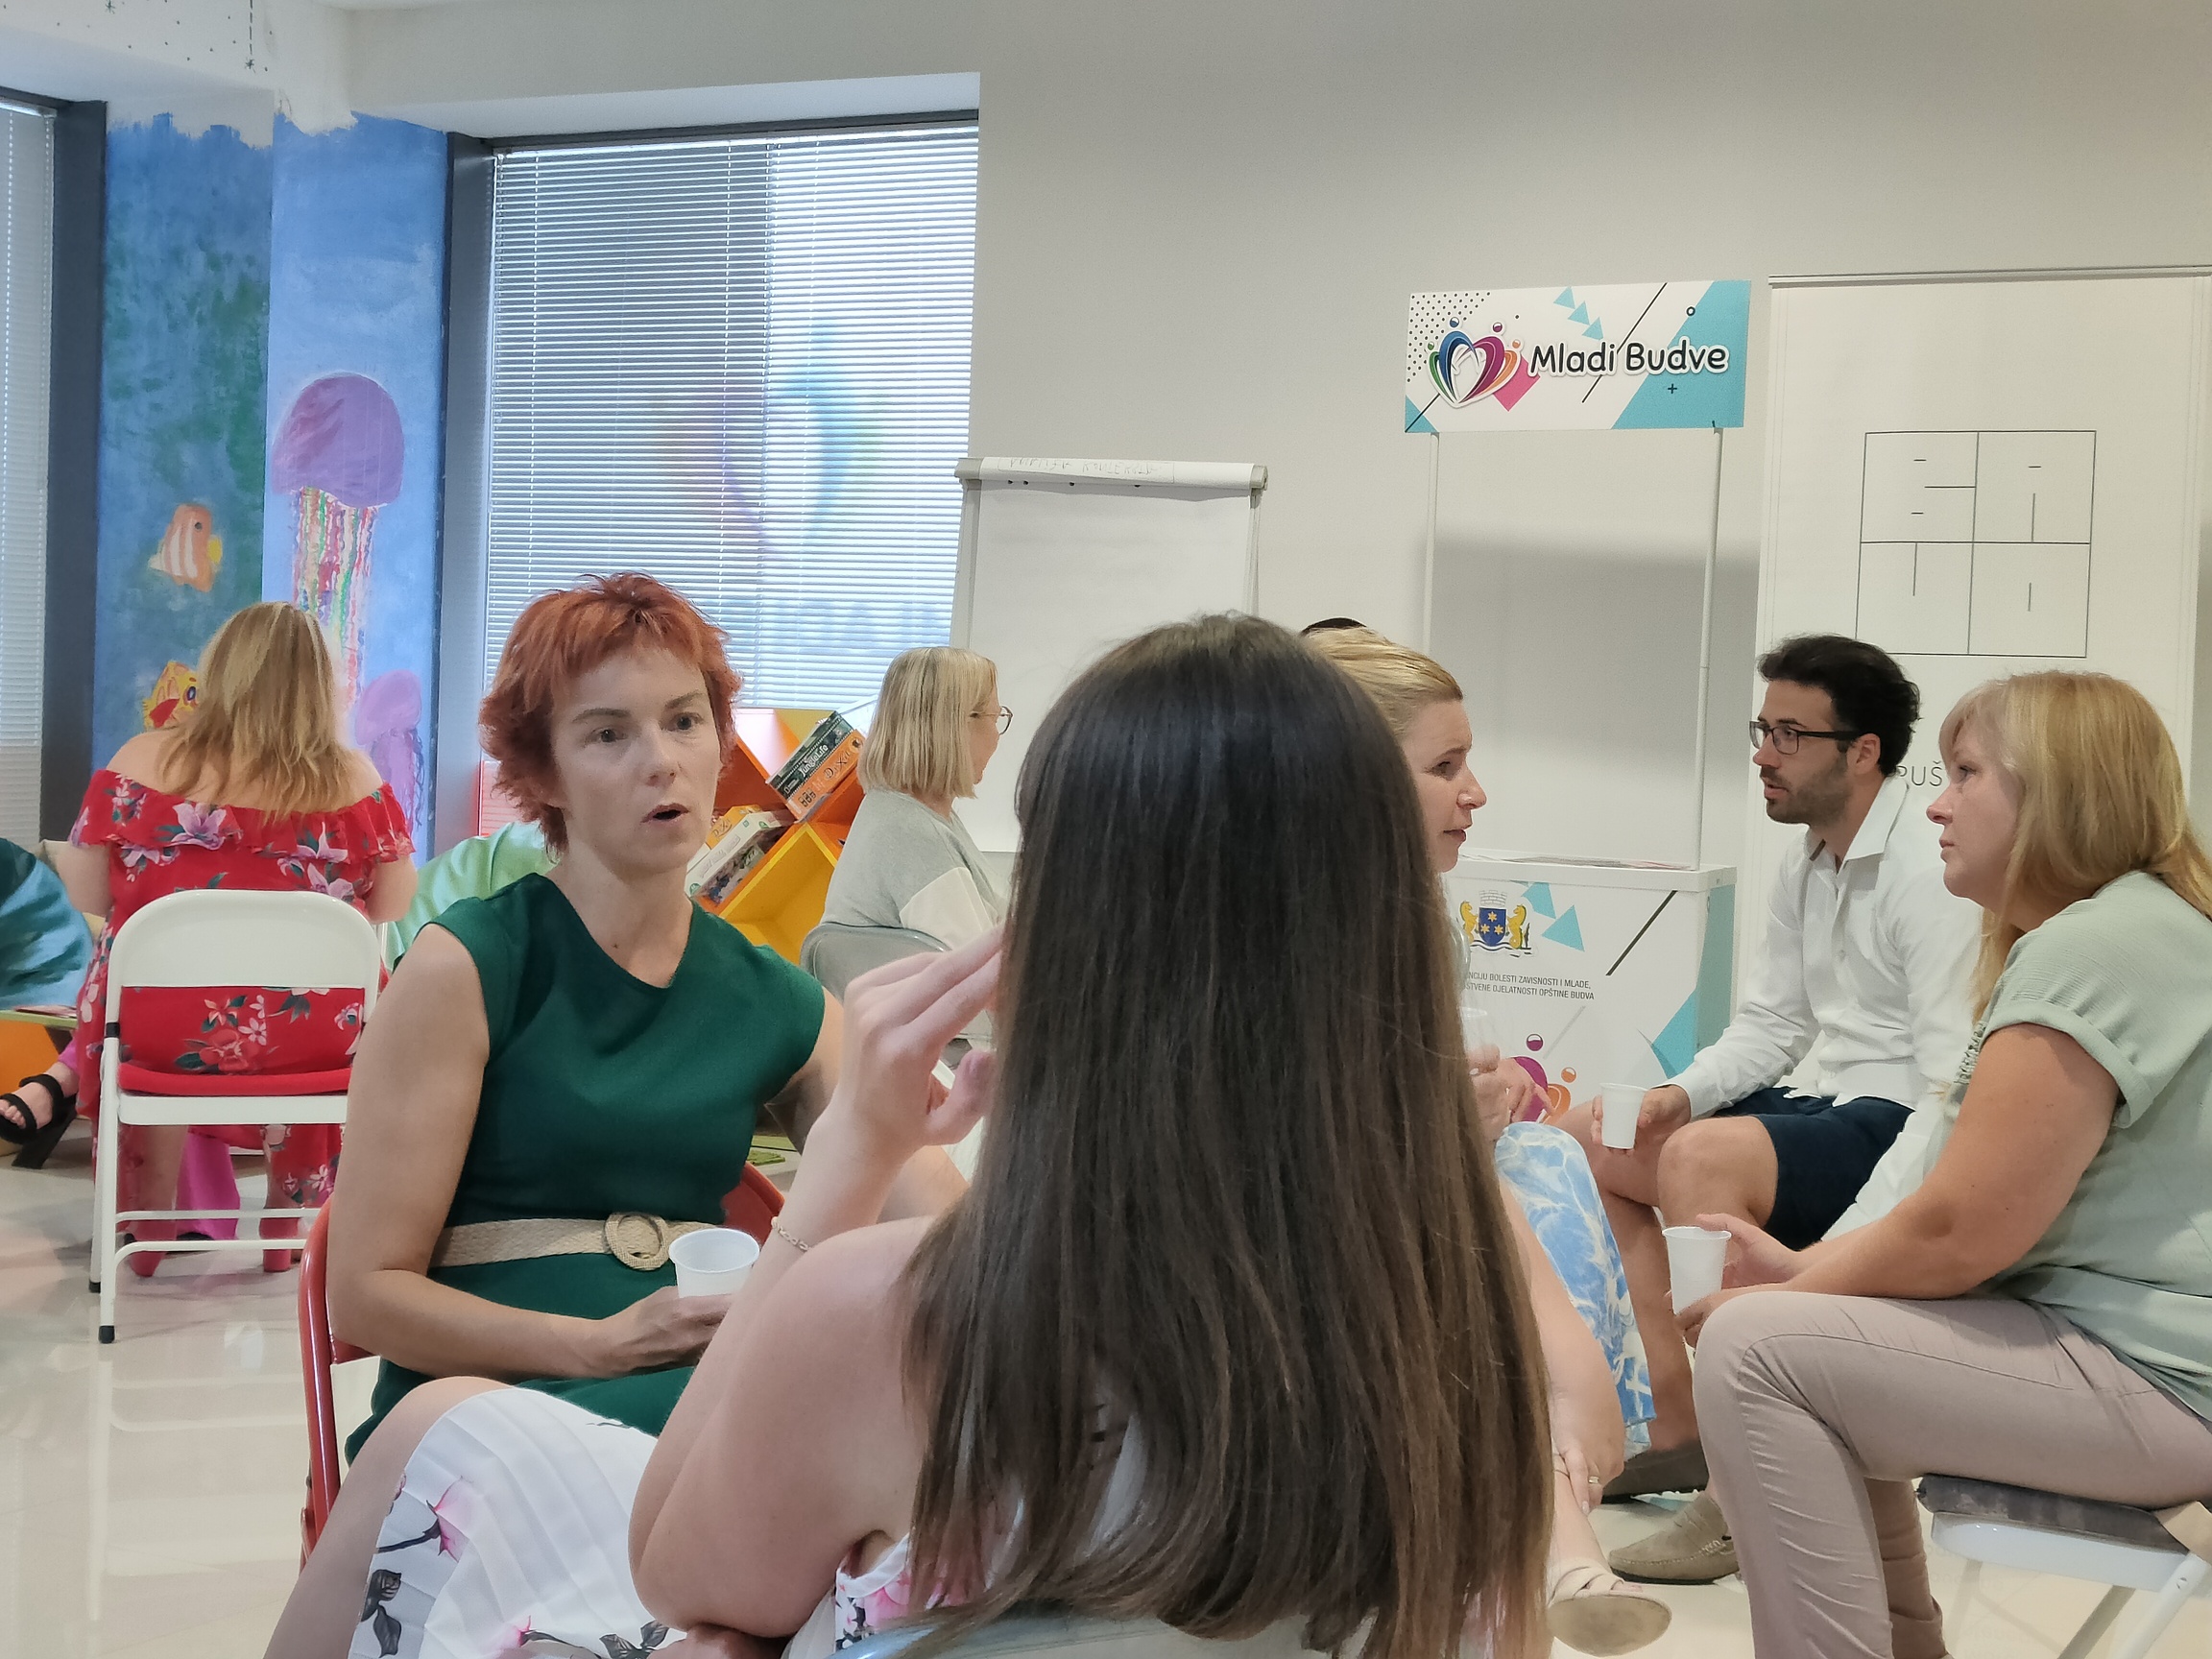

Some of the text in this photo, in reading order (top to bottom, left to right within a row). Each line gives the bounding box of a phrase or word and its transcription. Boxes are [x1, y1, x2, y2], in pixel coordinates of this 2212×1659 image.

[1530, 339, 1727, 374] Mladi Budve
[1489, 973, 1517, 983] BOLESTI
[1518, 974, 1559, 987] ZAVISNOSTI
[1492, 984, 1538, 996] DJELATNOSTI
[1539, 987, 1570, 998] OPŠTINE
[1570, 991, 1595, 1000] BUDVA
